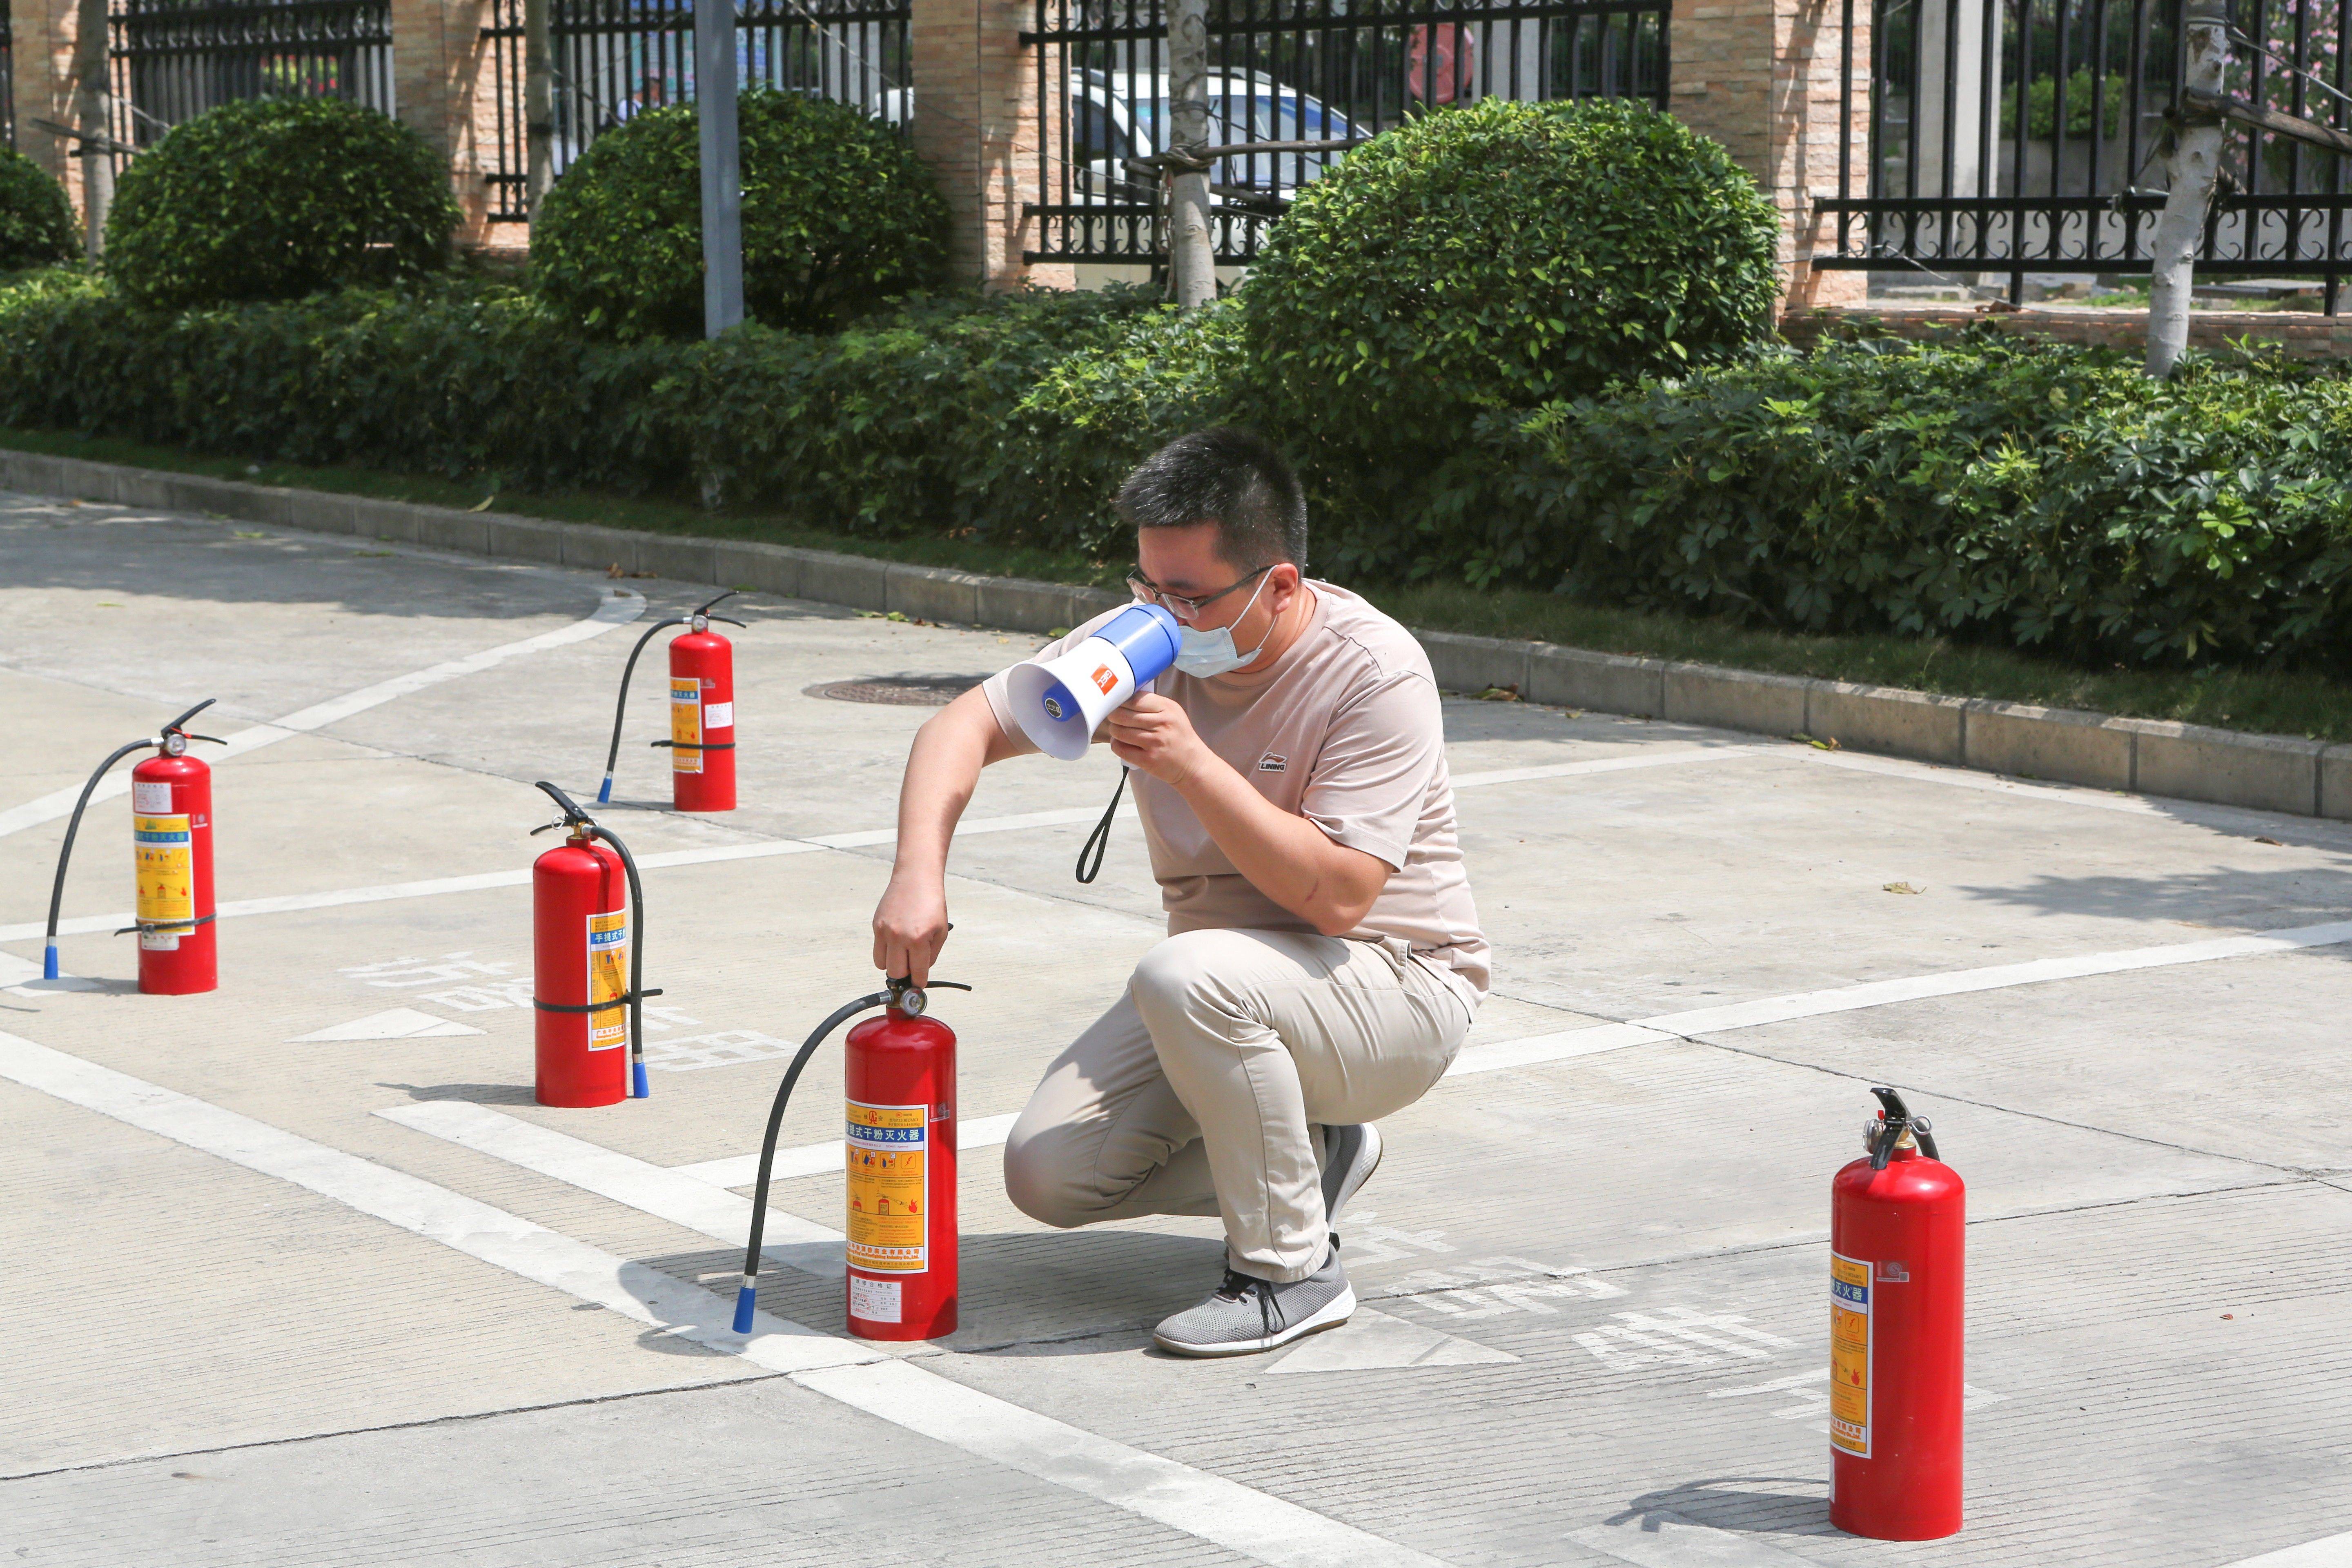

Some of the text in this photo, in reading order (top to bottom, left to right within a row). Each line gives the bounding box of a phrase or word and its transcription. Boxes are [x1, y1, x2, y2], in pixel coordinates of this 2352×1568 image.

[1097, 669, 1113, 688] GIEC
[846, 1123, 919, 1141] 手提式干粉灭火器
